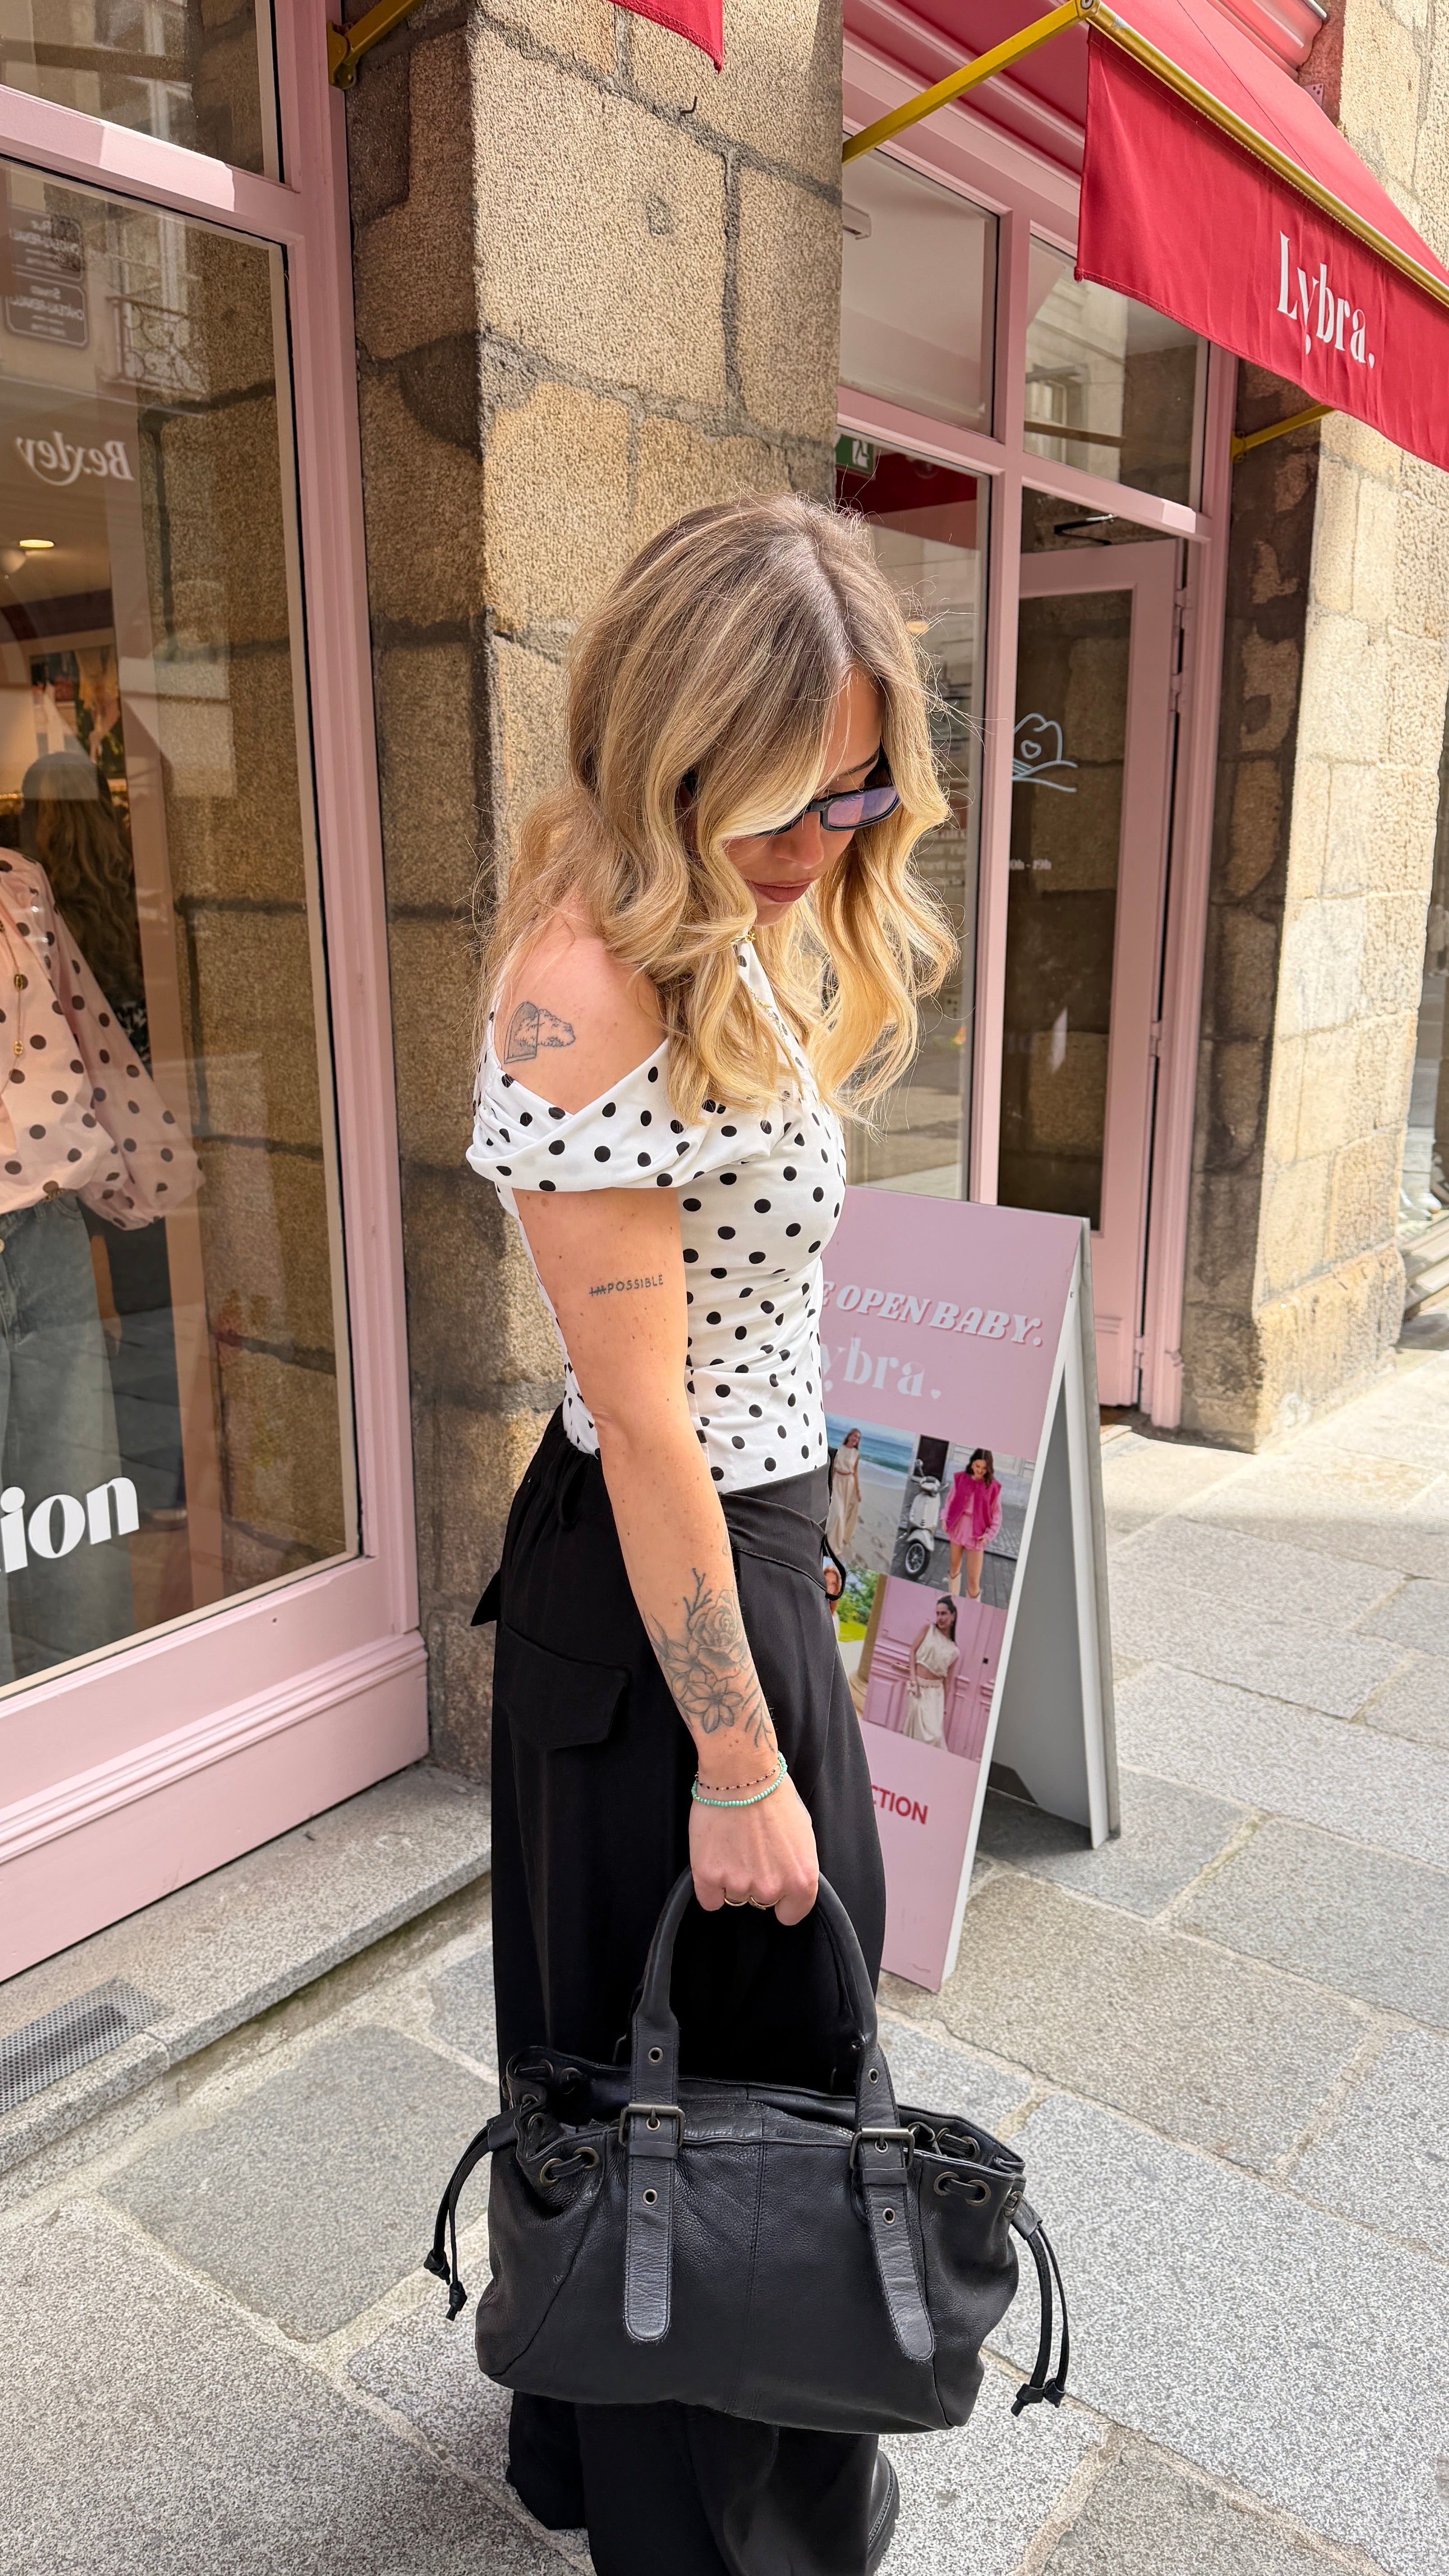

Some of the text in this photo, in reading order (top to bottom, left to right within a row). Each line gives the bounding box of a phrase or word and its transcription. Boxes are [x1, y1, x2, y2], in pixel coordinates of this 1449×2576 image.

[1277, 231, 1375, 368] Lybra.
[837, 1284, 932, 1325] OPEN
[929, 1301, 1043, 1347] BABY.
[821, 1337, 941, 1399] ybra.
[0, 1477, 139, 1573] ion
